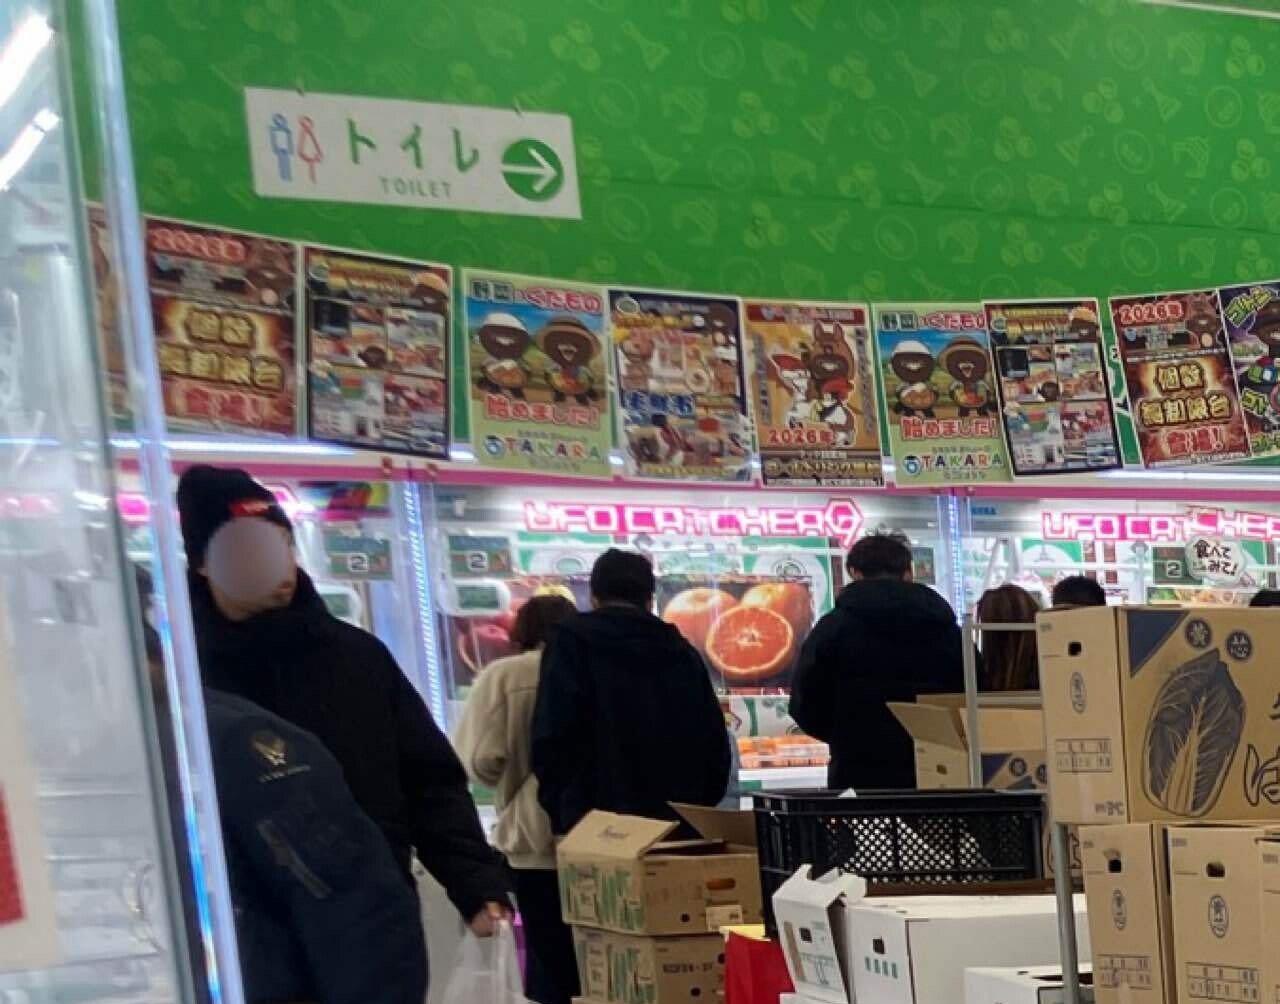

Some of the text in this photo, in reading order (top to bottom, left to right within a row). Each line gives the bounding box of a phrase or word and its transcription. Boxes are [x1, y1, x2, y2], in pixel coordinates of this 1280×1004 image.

[347, 119, 480, 173] トイレ
[380, 176, 451, 199] TOILET
